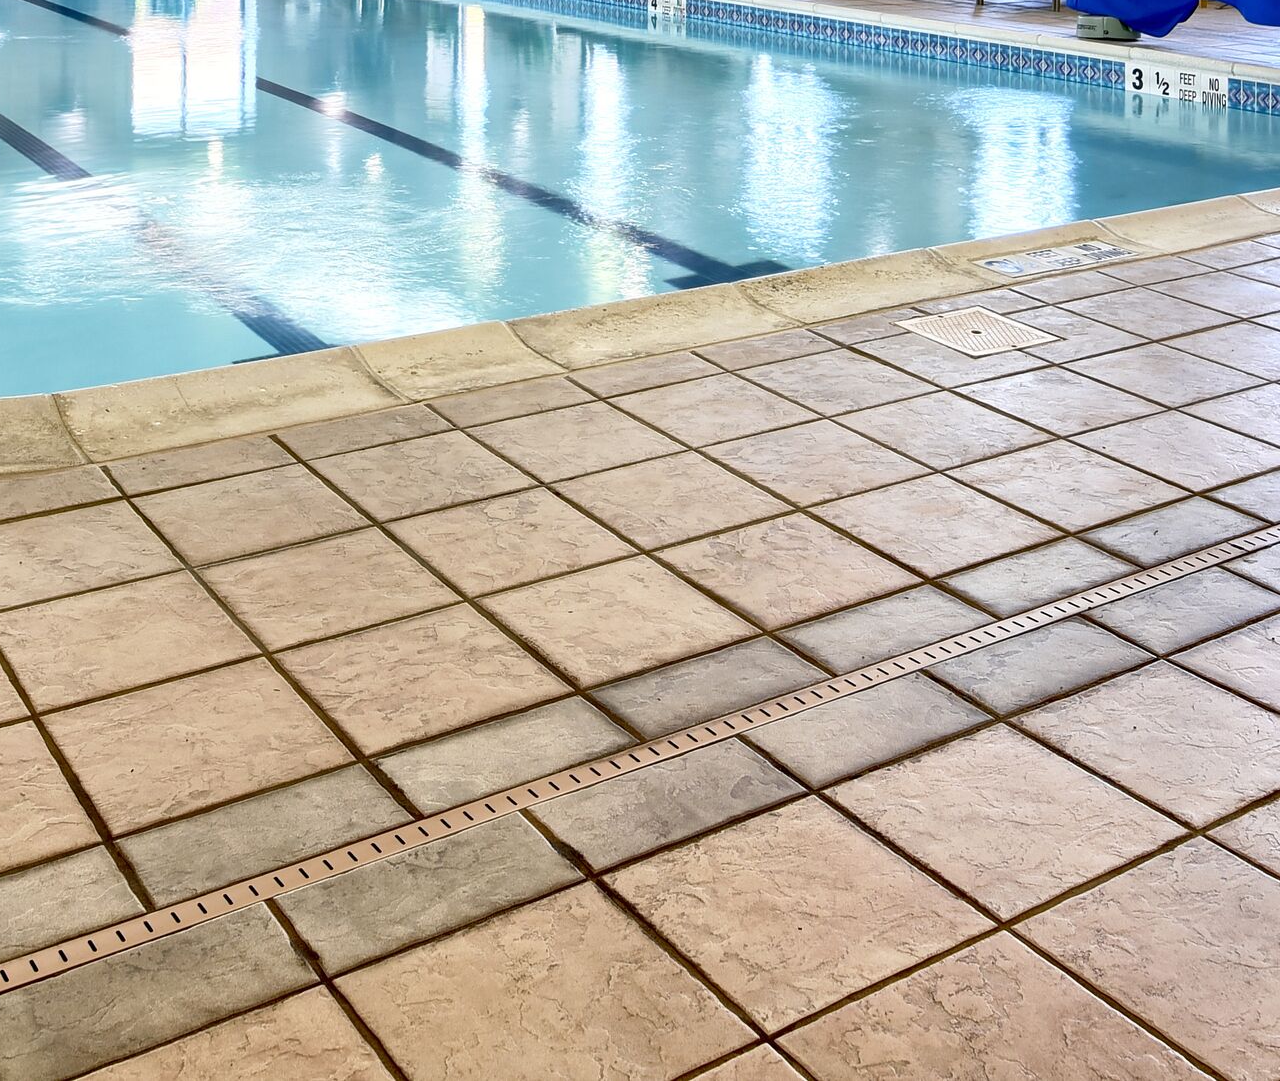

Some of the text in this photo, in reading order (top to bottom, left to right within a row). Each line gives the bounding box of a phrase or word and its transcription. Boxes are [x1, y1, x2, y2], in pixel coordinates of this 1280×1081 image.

[1132, 68, 1144, 90] 3
[1180, 72, 1196, 87] FEET
[1208, 77, 1220, 92] NO
[1179, 88, 1197, 102] DEEP
[1202, 91, 1227, 108] DIVING
